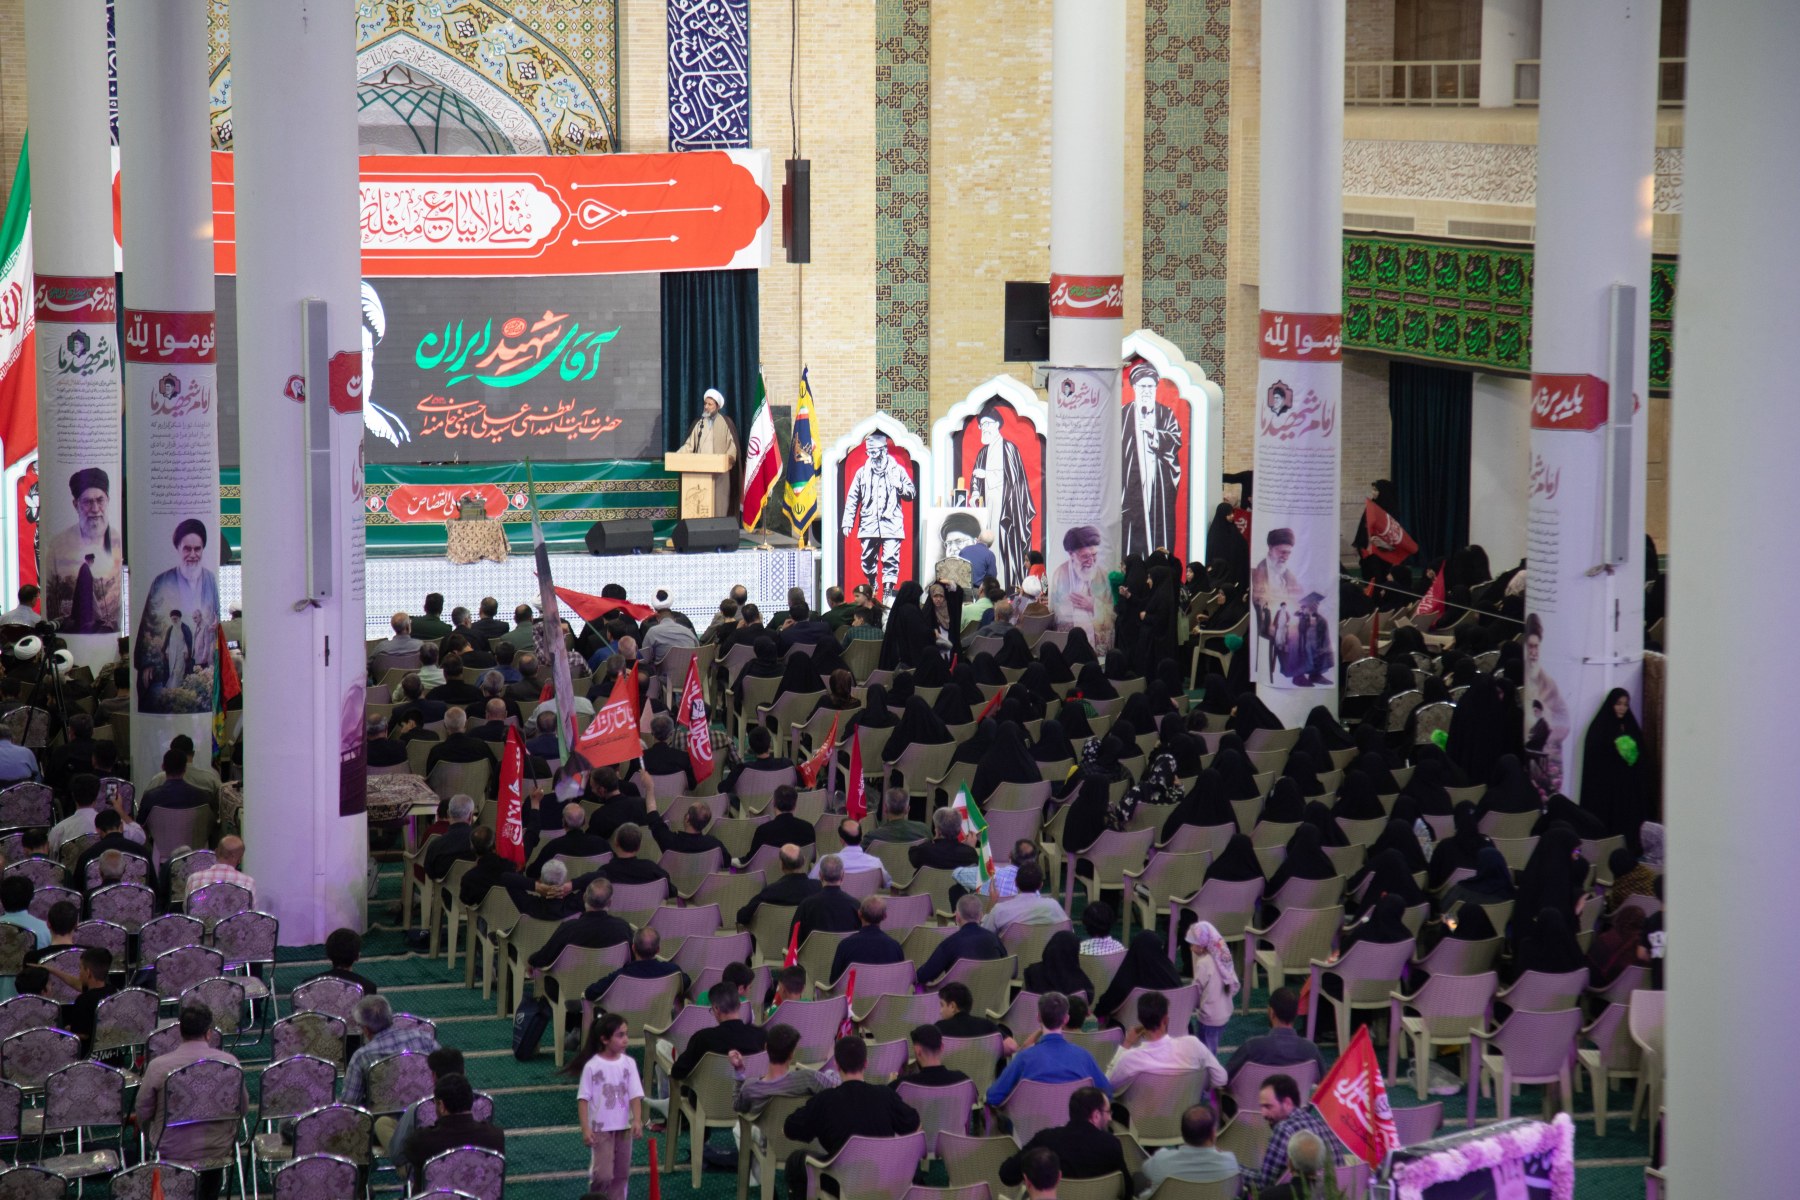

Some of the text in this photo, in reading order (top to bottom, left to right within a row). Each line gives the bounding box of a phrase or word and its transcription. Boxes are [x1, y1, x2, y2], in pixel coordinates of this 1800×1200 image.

[58, 336, 109, 376] شهید
[155, 322, 215, 357] قوموا
[415, 309, 622, 388] آقای شهید ایران
[151, 379, 201, 417] شهید
[1261, 389, 1322, 441] شهید
[471, 403, 532, 439] علی
[579, 415, 623, 441] حضرت
